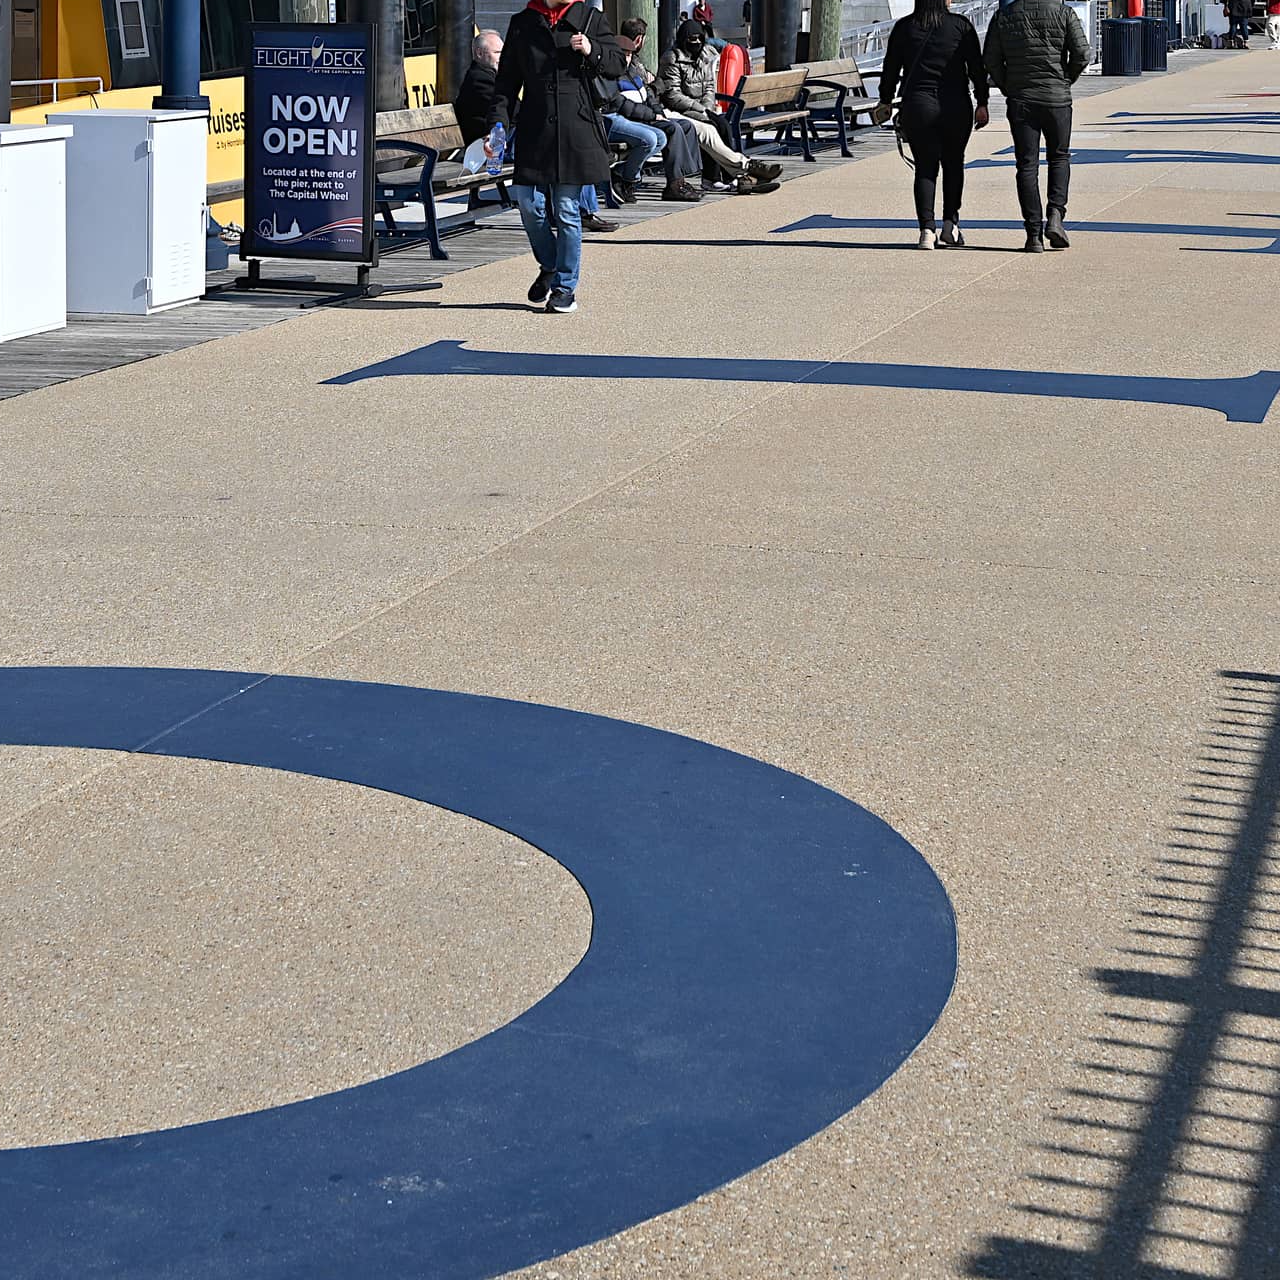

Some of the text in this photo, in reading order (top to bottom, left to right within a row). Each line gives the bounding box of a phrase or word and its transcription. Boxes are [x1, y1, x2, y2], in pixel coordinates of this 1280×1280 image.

[257, 50, 363, 67] FLIGHT DECK
[272, 94, 351, 123] NOW
[263, 127, 358, 156] OPEN!
[263, 167, 357, 179] Located at the end of
[274, 178, 344, 189] the pier, next to
[269, 189, 349, 201] The Capital Wheel
